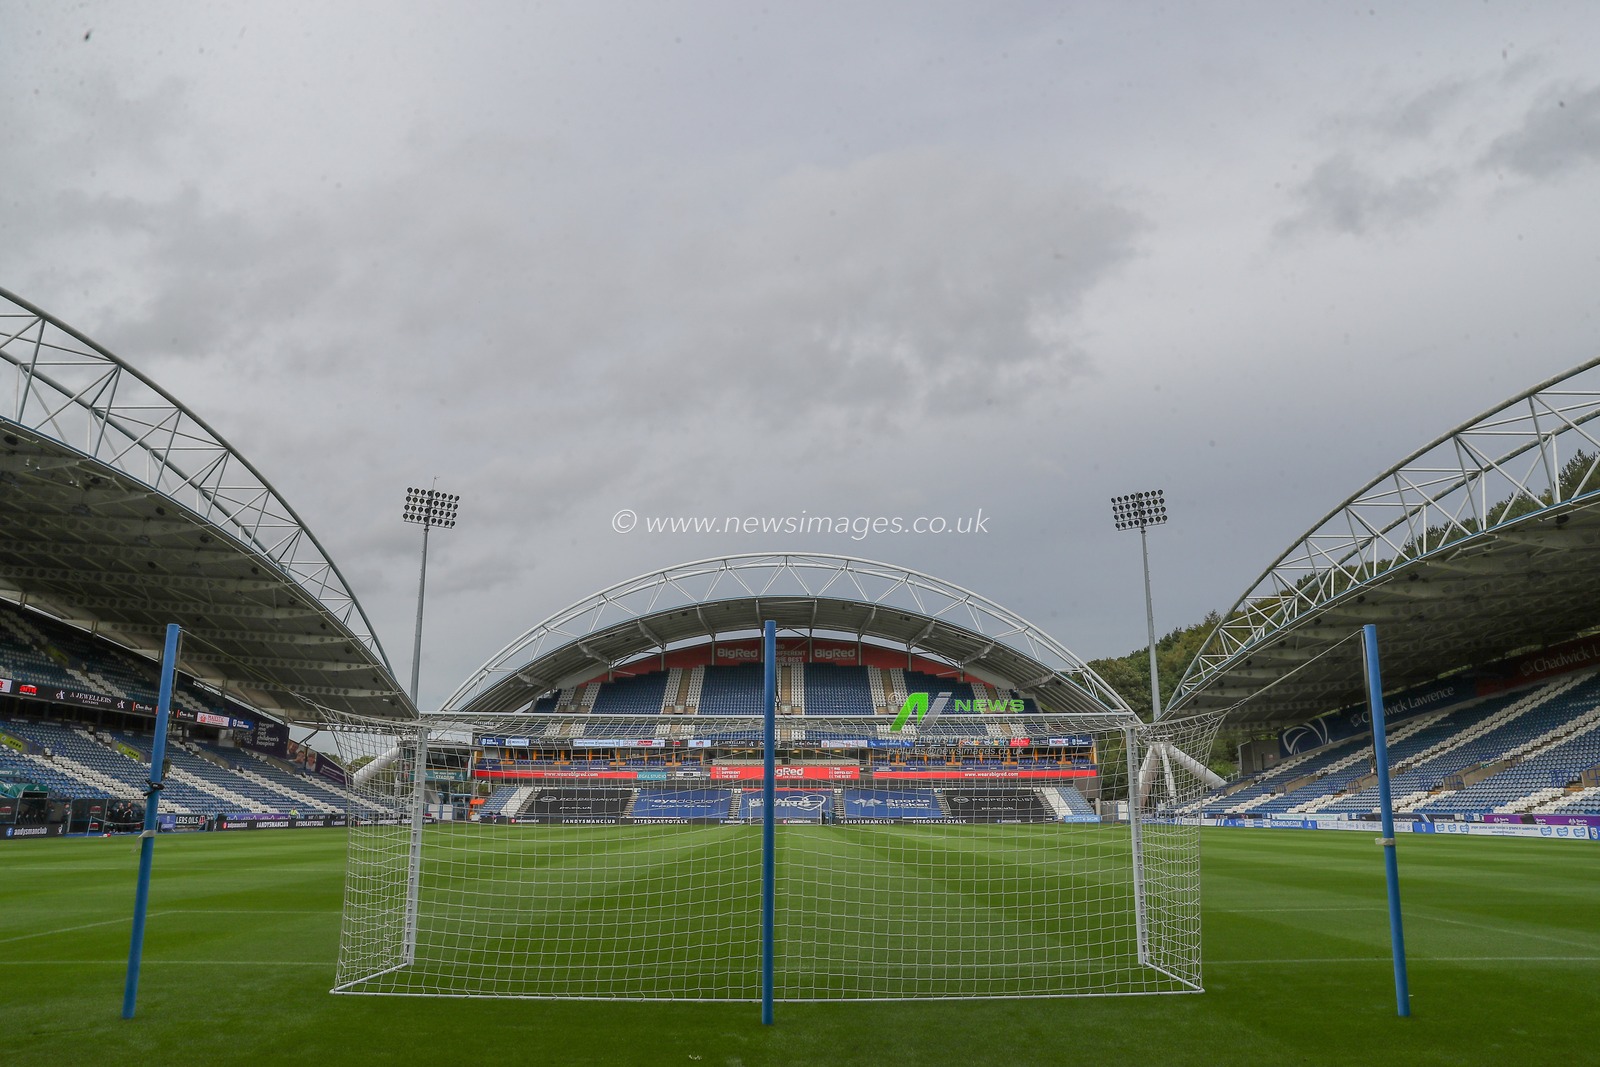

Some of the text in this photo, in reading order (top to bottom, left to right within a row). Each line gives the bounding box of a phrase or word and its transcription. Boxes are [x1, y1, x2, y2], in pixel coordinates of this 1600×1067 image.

[717, 648, 758, 659] BigRed
[814, 648, 855, 659] BigRed
[1534, 646, 1591, 672] Chadwick
[76, 692, 112, 703] JEWELLERS
[1361, 685, 1455, 723] Cwick Lawrence
[13, 826, 47, 836] andysmanclub
